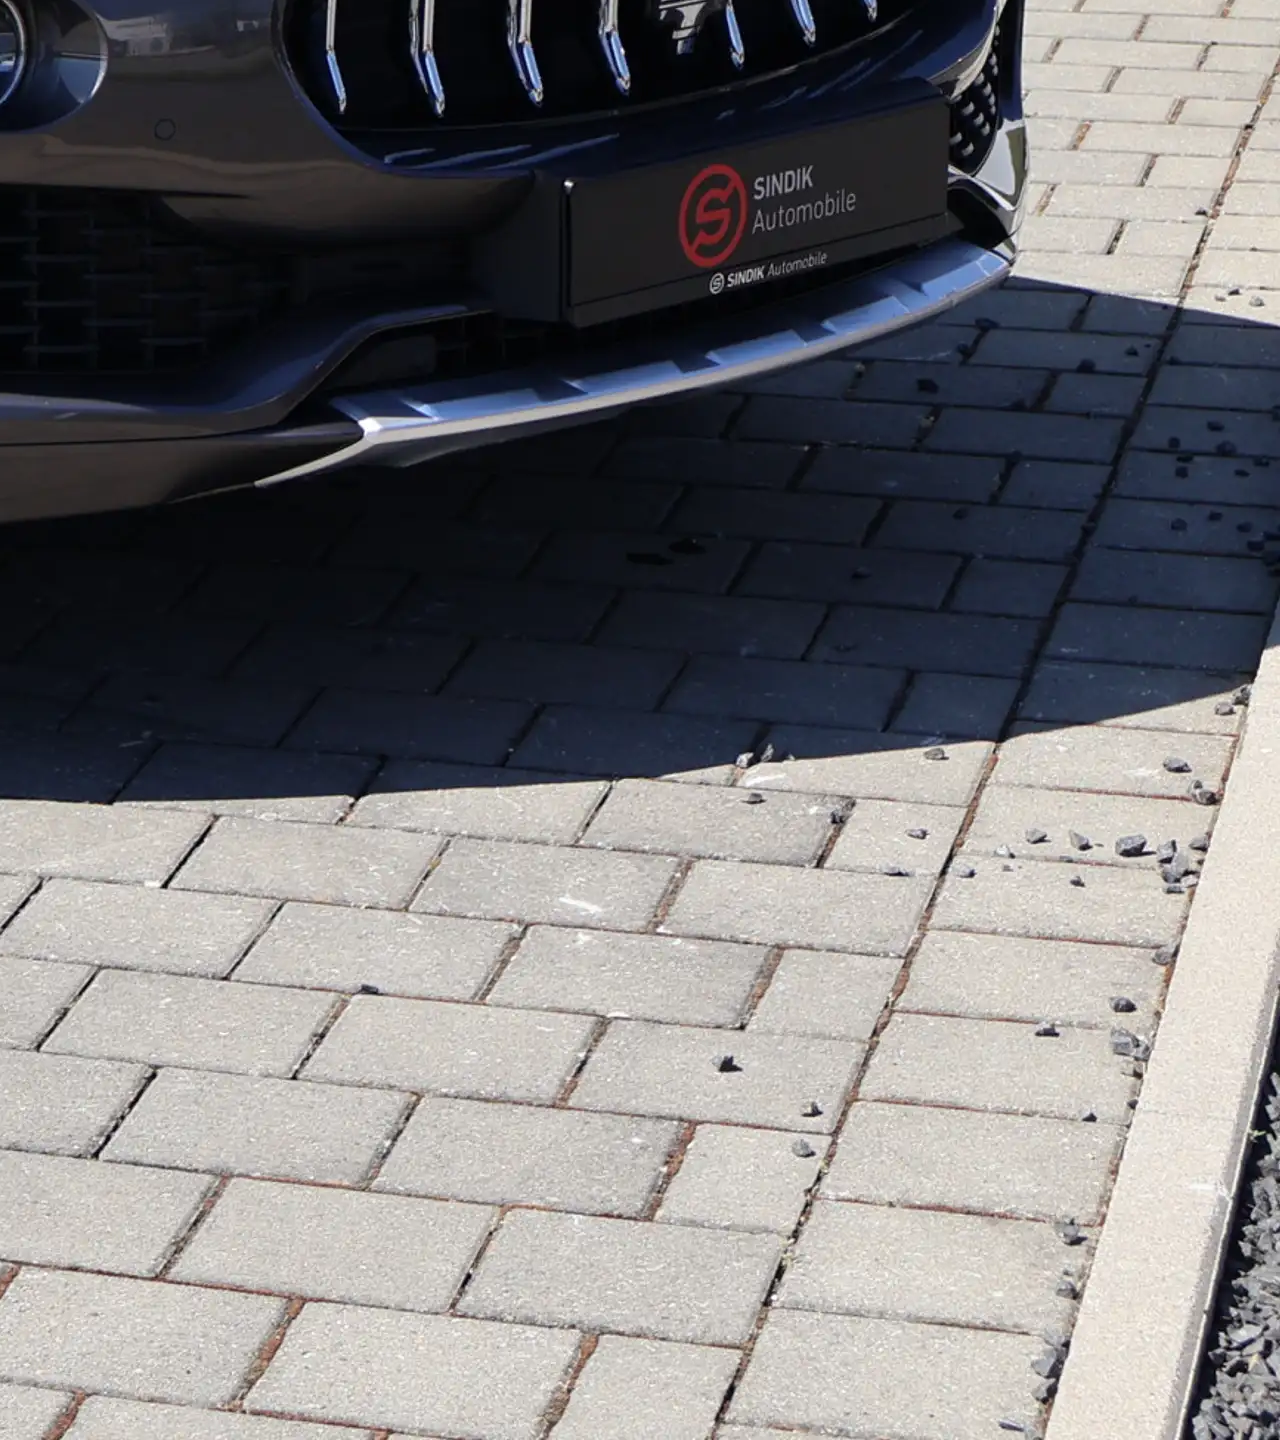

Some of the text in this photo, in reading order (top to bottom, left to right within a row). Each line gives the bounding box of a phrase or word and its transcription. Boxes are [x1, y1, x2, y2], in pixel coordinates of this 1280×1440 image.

[753, 165, 814, 200] SINDIK
[752, 188, 856, 234] Automobile
[726, 265, 765, 288] SINDIK
[767, 251, 828, 276] Automobile
